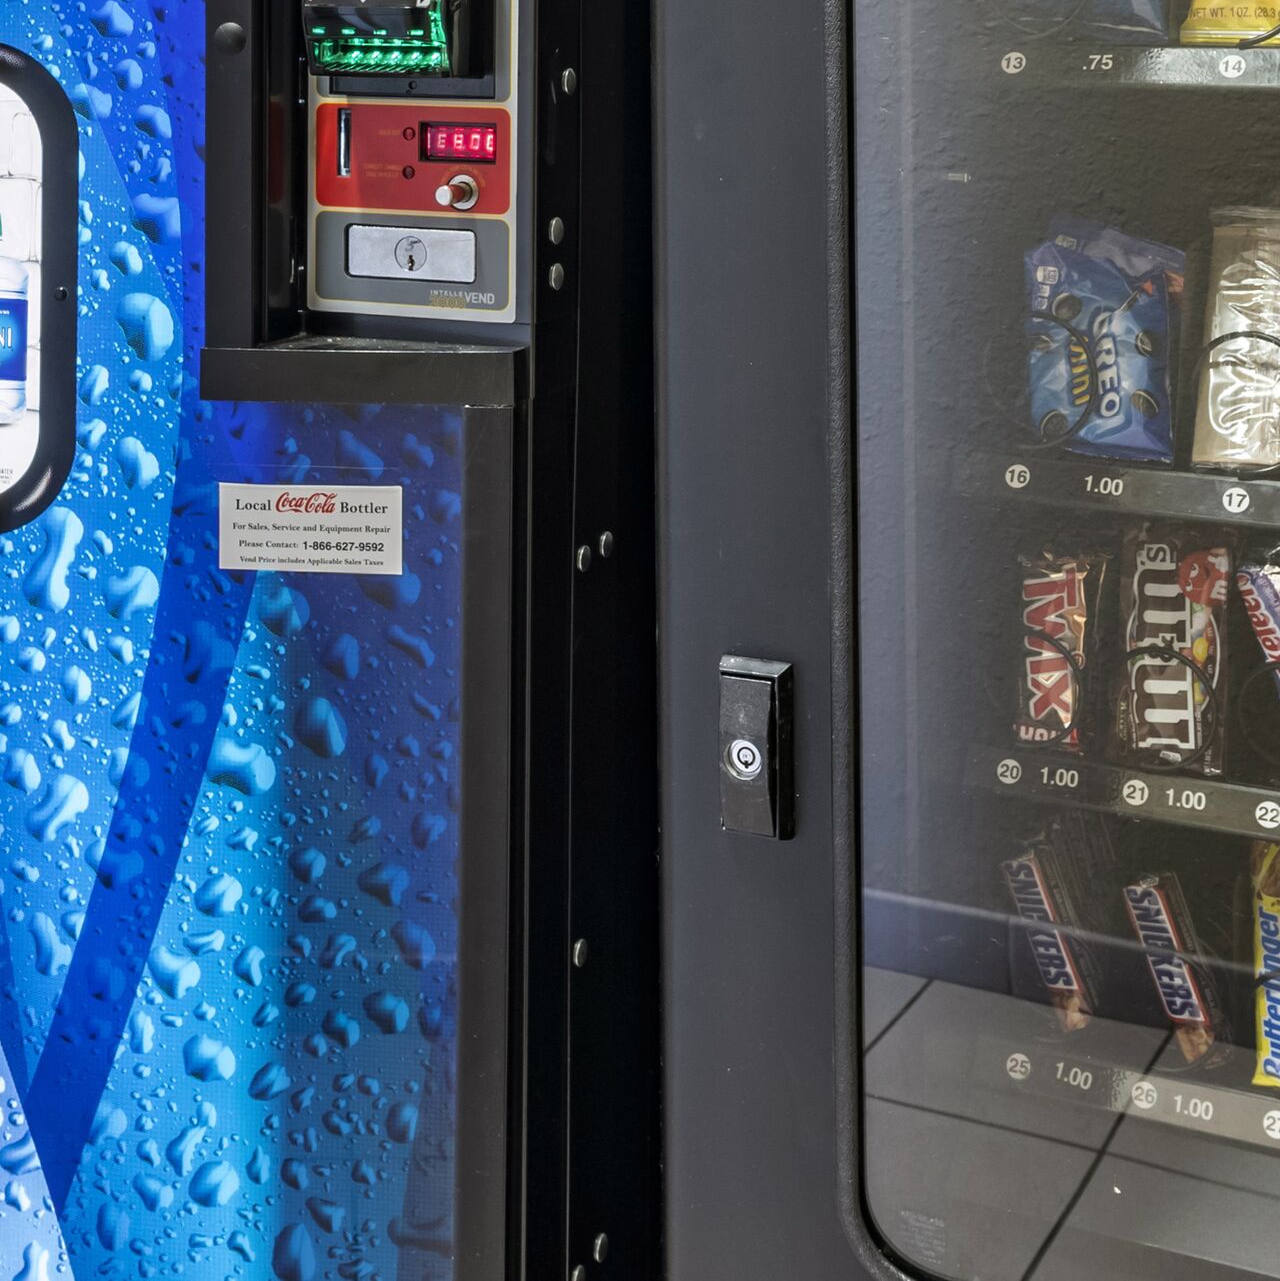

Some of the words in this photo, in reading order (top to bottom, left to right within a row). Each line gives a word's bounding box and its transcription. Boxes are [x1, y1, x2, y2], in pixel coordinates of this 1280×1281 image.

[1081, 53, 1114, 71] .75
[1092, 309, 1121, 418] OREO
[1082, 474, 1124, 497] 1.00
[235, 498, 271, 512] Local
[274, 491, 339, 514] Coca-Cola
[340, 501, 389, 514] Bottler
[232, 522, 246, 531] For
[247, 522, 270, 532] Sales,
[271, 523, 301, 532] Service
[302, 524, 317, 532] and
[319, 524, 363, 534] Equipment
[364, 526, 391, 534] Repair
[238, 539, 264, 548] Please
[265, 541, 299, 549] Contact:
[302, 541, 385, 552] 1-866-627-9592
[239, 555, 257, 563] Vend
[258, 556, 276, 564] Price
[307, 557, 342, 566] Applicable
[1039, 766, 1079, 788] 1.00
[1165, 788, 1207, 811] 1.00
[1055, 1060, 1093, 1091] 1.00
[1173, 1094, 1214, 1121] 1.00
